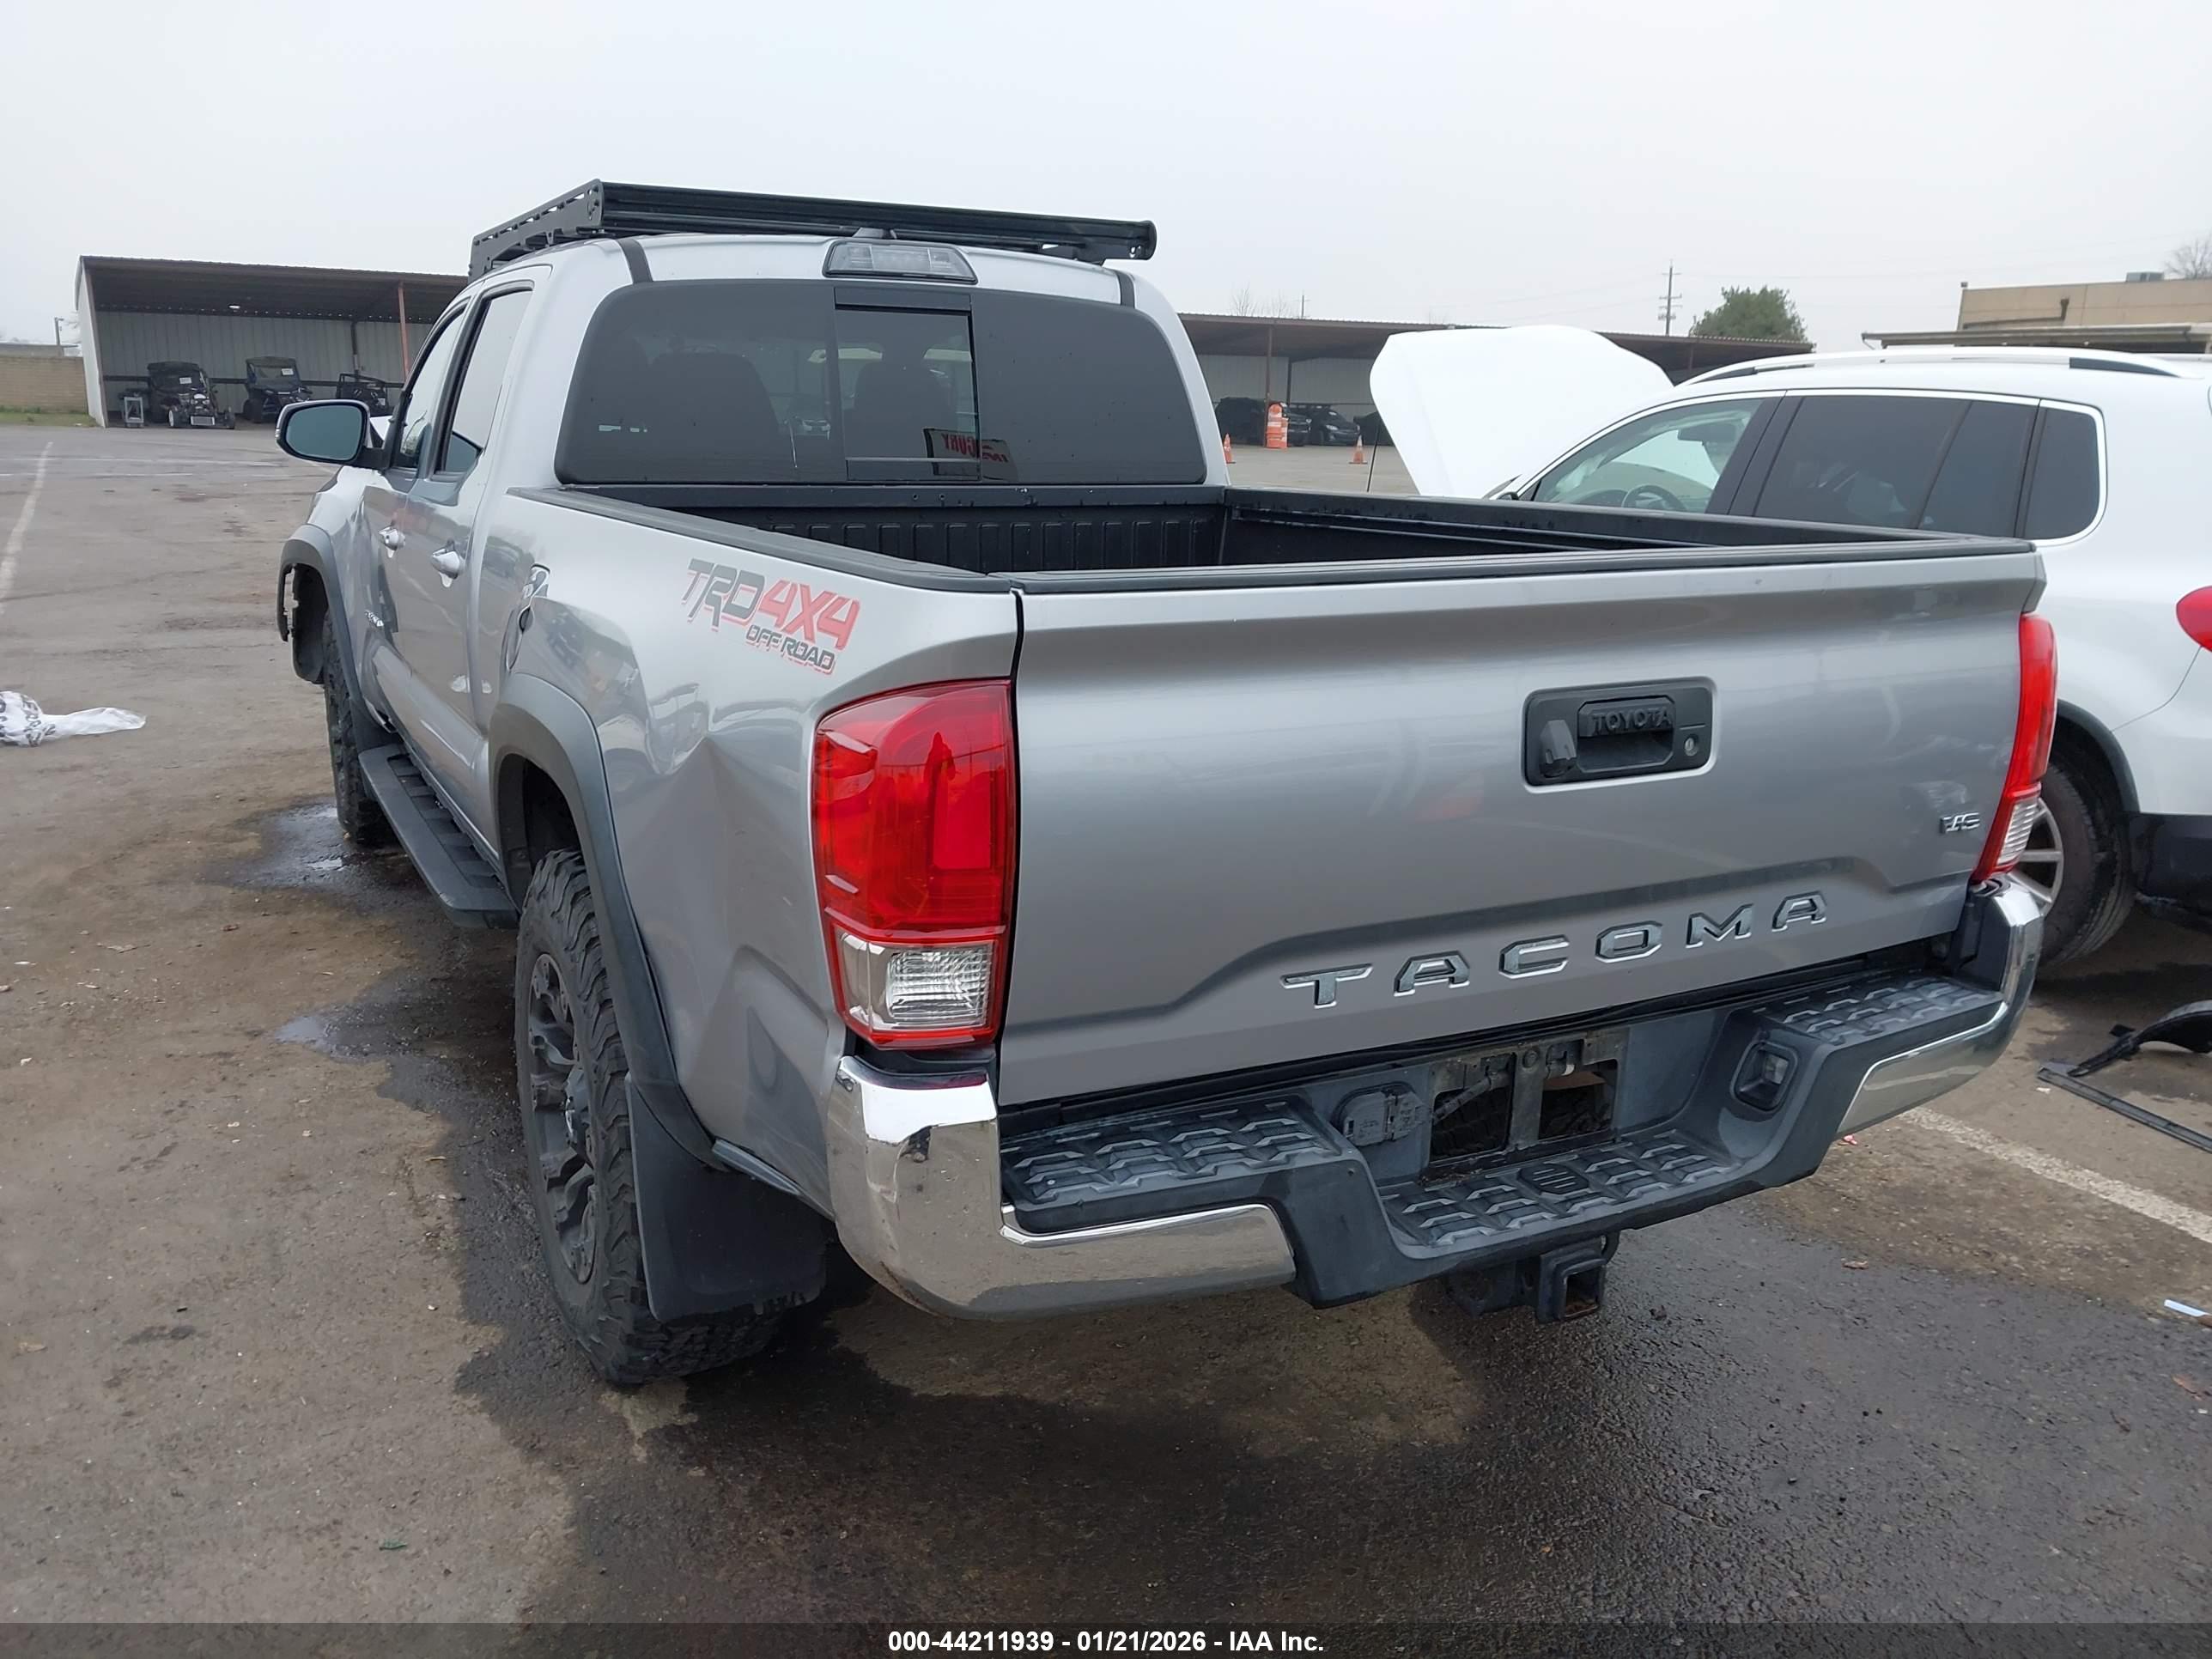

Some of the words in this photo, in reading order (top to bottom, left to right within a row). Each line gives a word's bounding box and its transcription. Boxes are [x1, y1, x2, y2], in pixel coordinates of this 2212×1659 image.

[681, 558, 765, 630] TRD
[745, 624, 782, 651] OFF
[780, 636, 836, 674] ROAD
[1591, 707, 1672, 735] TOYOTA
[1280, 890, 1827, 1008] TACOMA
